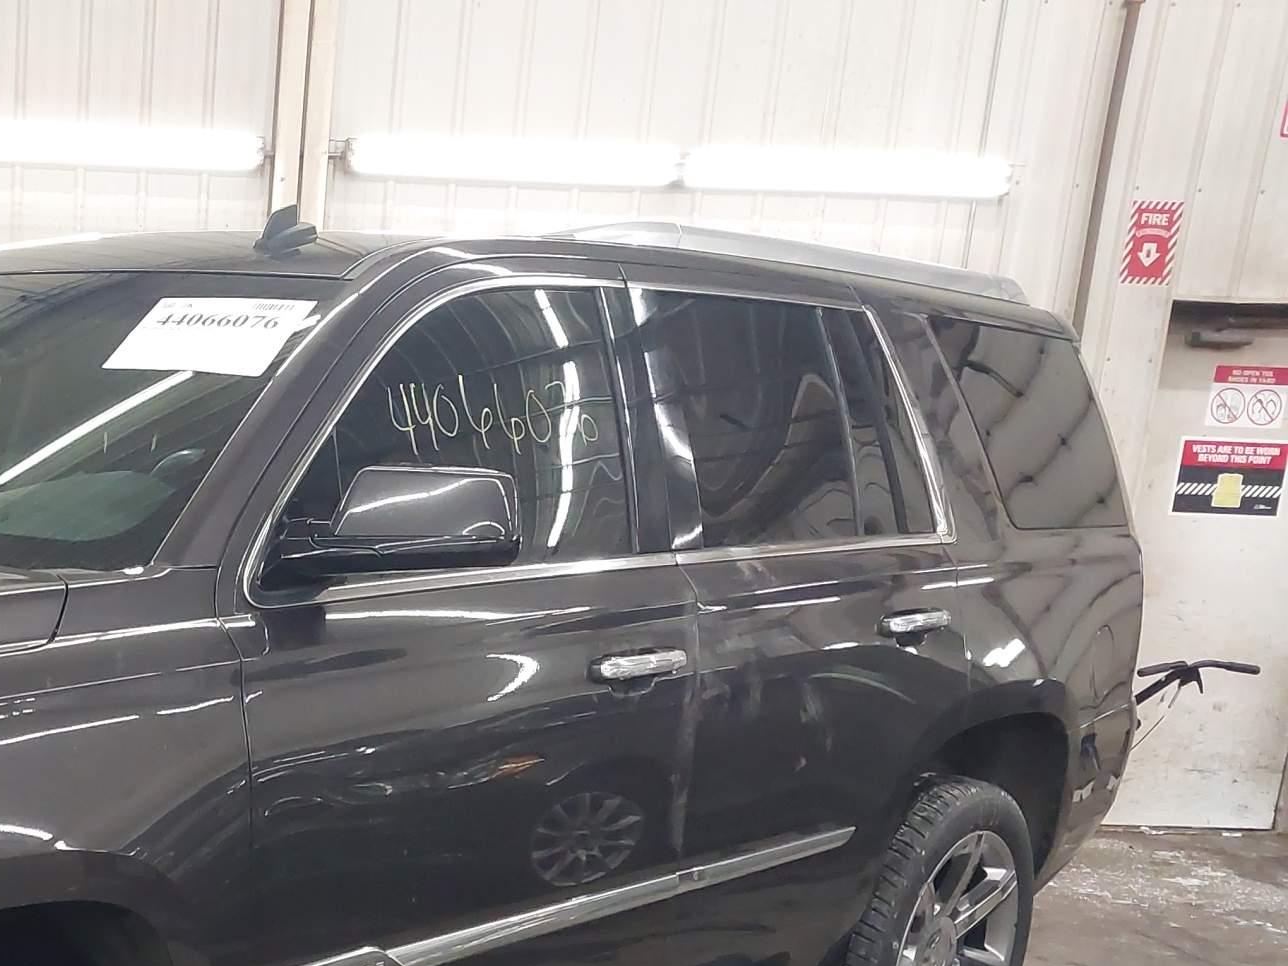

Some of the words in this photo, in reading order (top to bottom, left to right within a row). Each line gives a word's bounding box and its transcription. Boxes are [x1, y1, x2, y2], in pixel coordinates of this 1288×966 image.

[1141, 213, 1170, 225] FIRE
[157, 312, 280, 329] 44066076
[1192, 444, 1216, 454] VESTS
[1217, 445, 1233, 454] ARE
[1234, 446, 1244, 454] TO
[1245, 446, 1256, 455] BE
[1256, 446, 1281, 456] WORN
[1198, 454, 1230, 463] BEYOND
[1230, 455, 1247, 464] THIS
[1248, 456, 1272, 465] POINT
